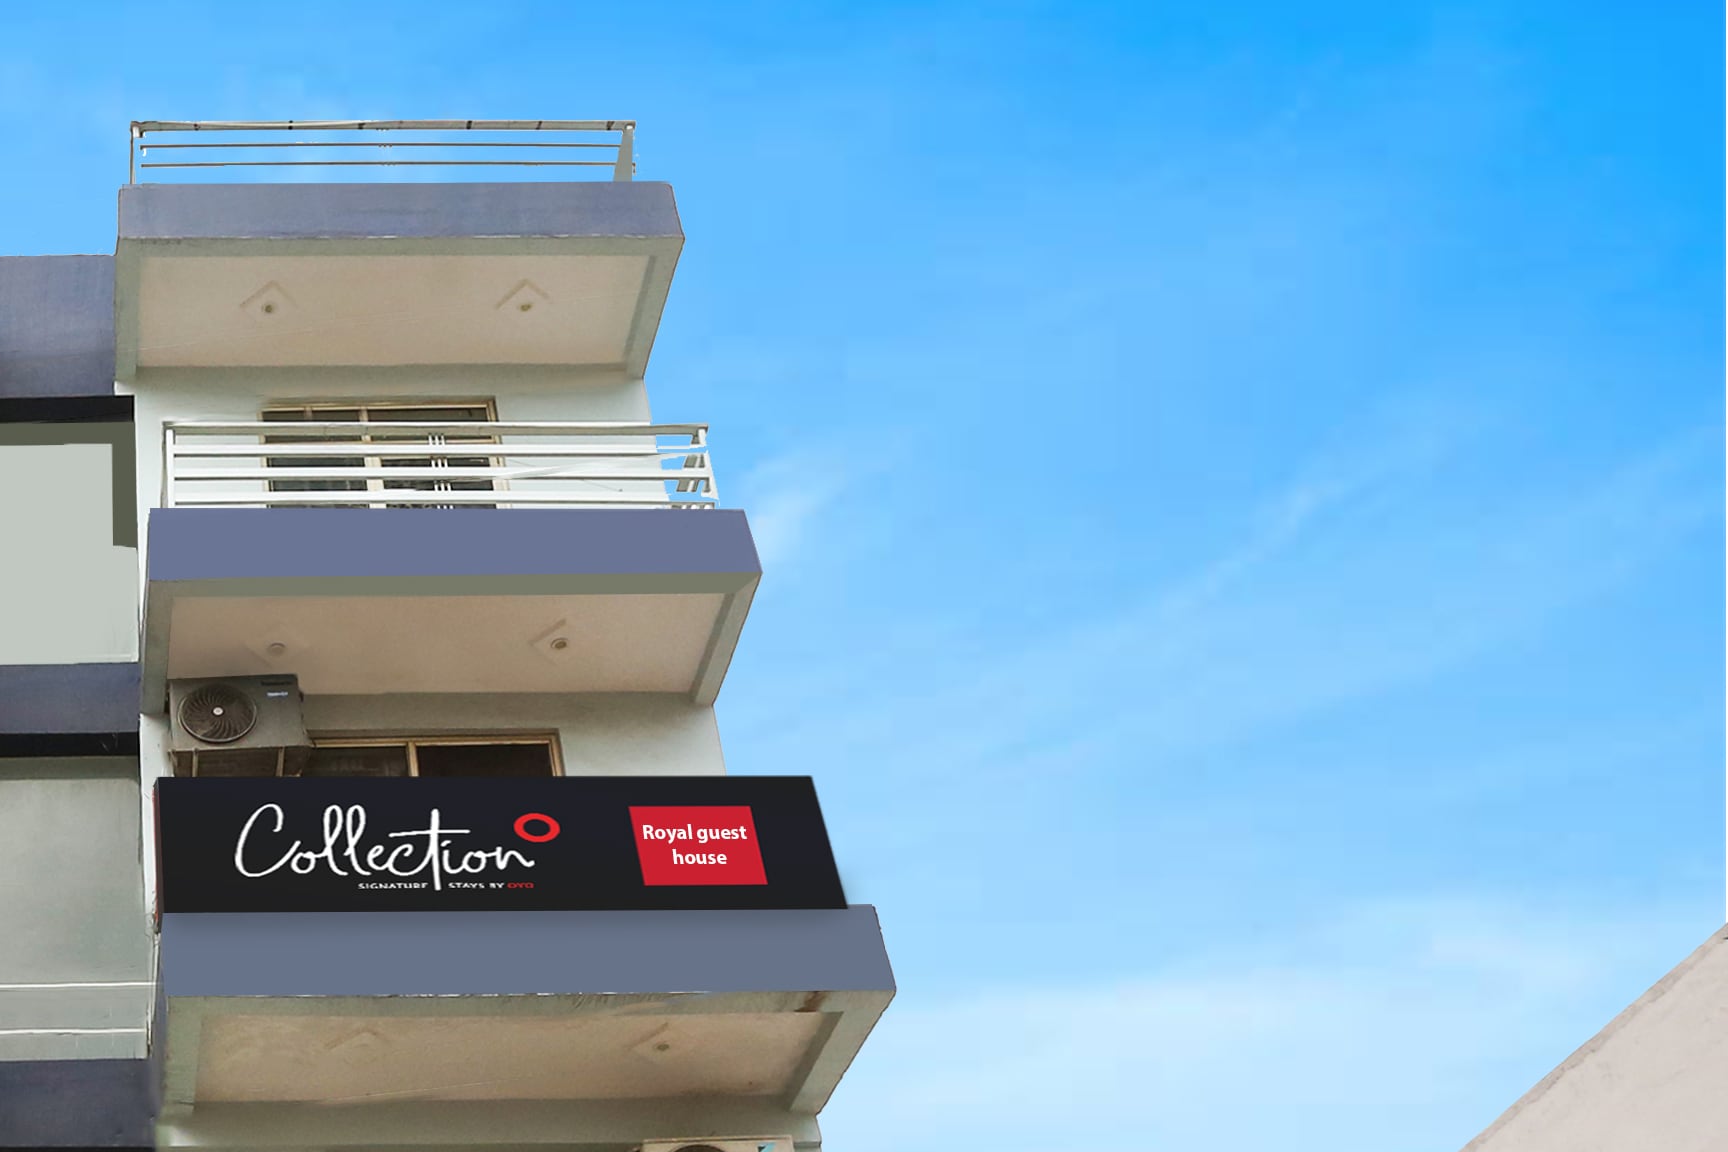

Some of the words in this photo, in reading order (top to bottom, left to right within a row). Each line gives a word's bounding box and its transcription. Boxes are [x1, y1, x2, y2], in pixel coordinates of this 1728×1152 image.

[642, 823, 693, 844] Royal
[696, 825, 748, 844] guest
[234, 803, 535, 891] Collection
[671, 848, 728, 866] house
